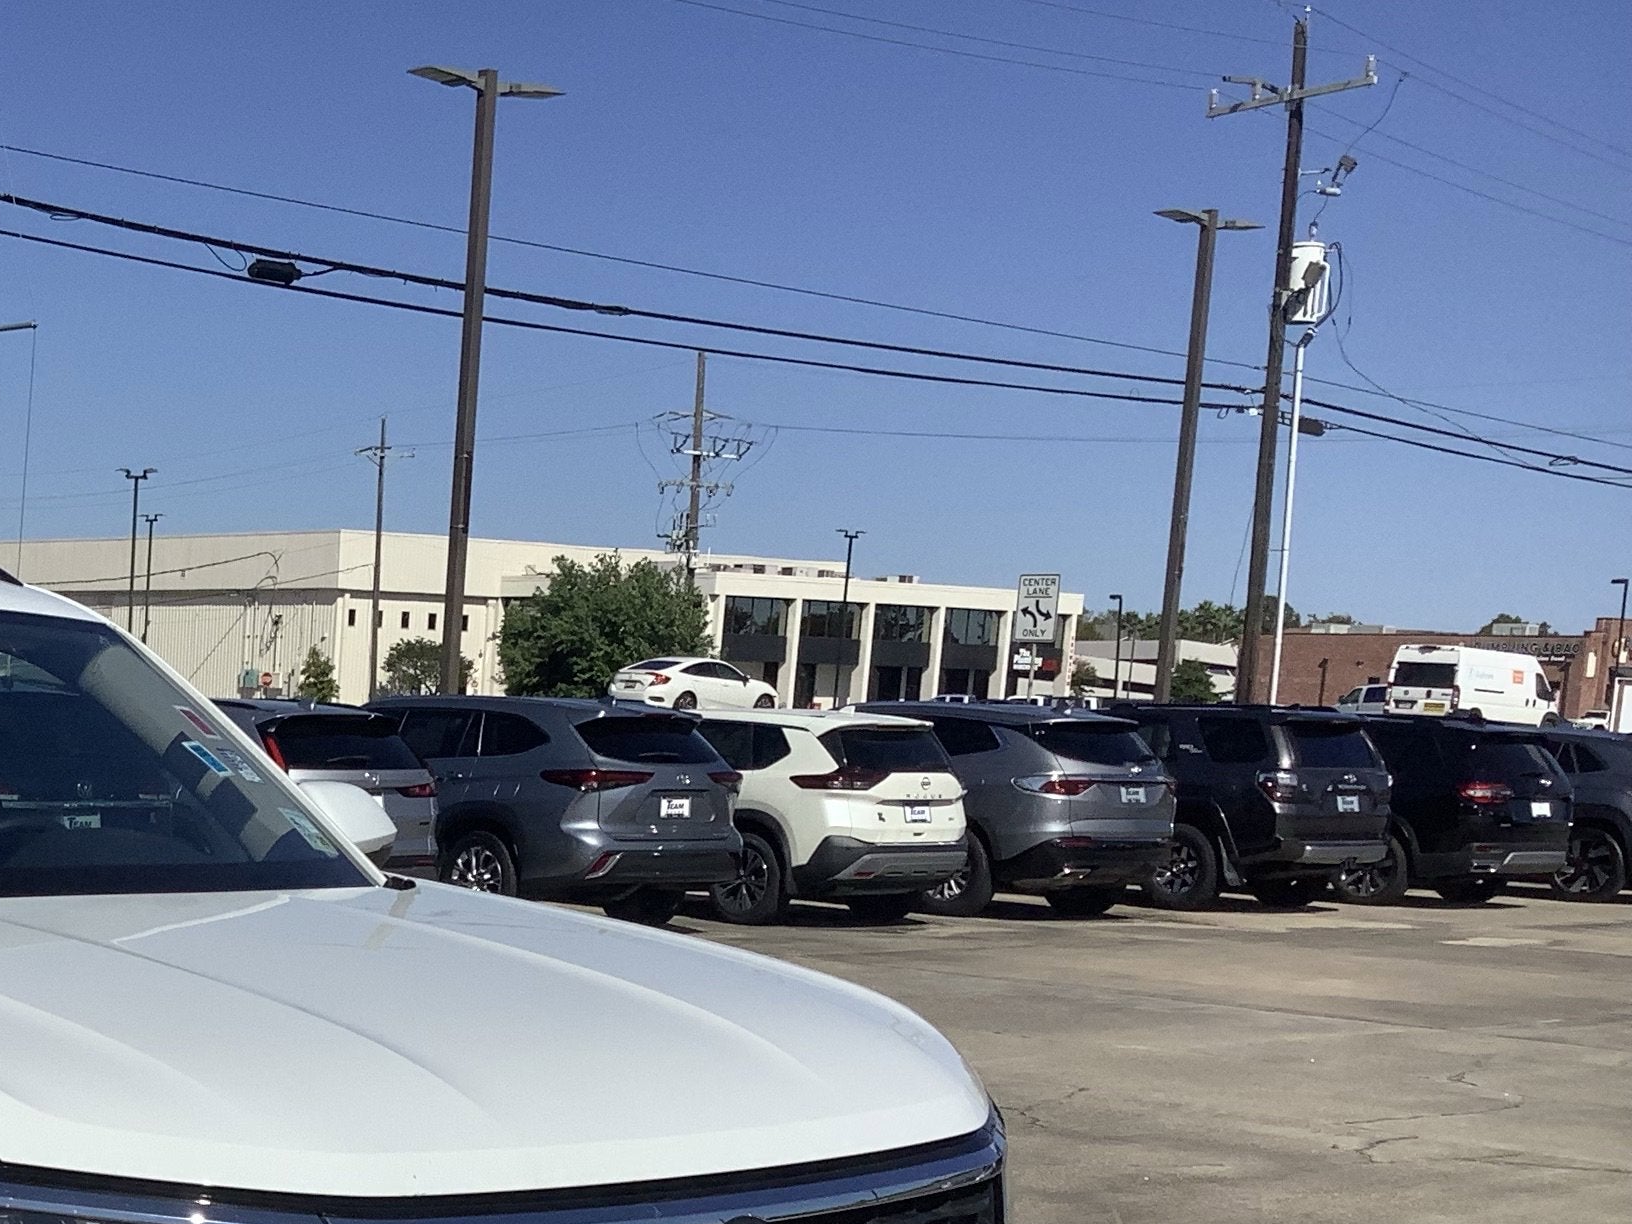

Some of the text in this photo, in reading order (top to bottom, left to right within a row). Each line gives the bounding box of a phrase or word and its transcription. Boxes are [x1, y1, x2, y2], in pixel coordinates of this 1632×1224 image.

[1022, 578, 1056, 587] CENTER
[1026, 587, 1051, 596] LANE
[1022, 629, 1047, 638] ONLY
